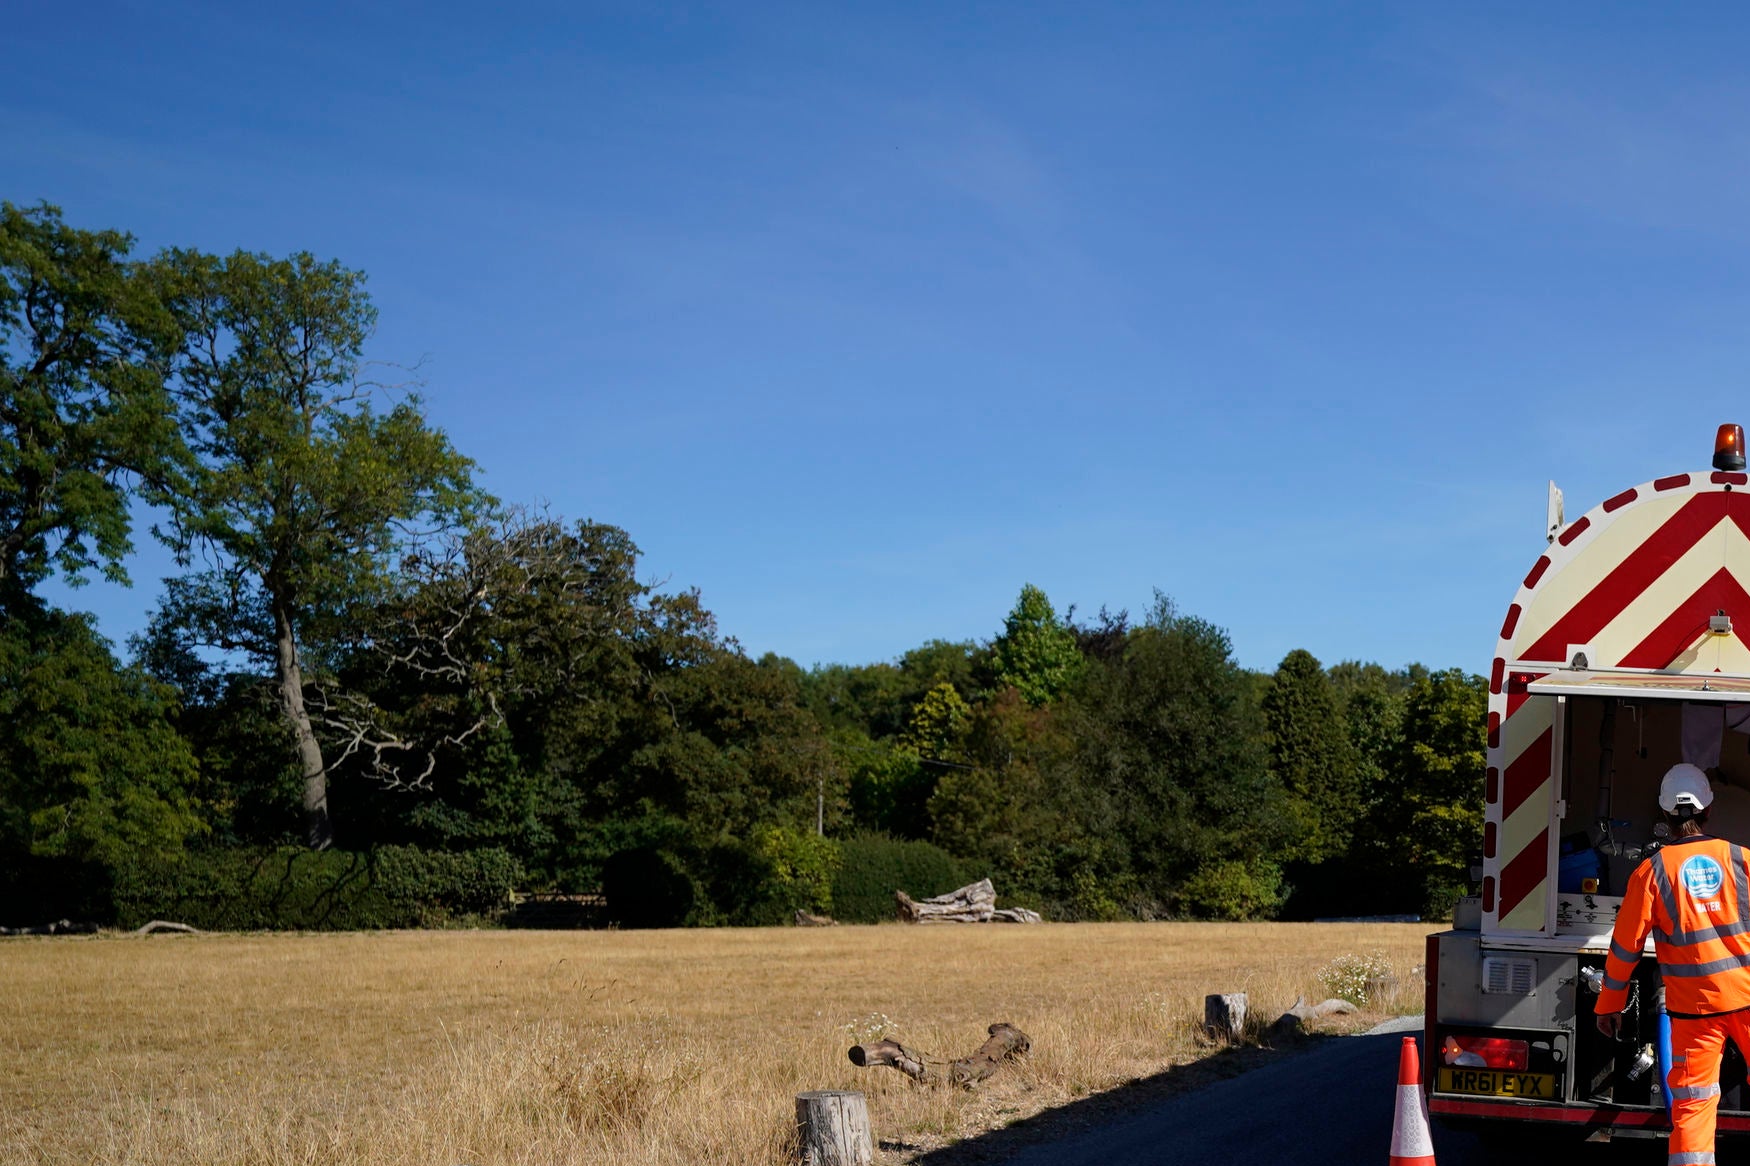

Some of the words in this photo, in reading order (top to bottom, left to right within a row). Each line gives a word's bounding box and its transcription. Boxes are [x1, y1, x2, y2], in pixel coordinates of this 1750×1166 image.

[1685, 867, 1717, 875] Thames
[1690, 874, 1714, 882] Water
[1695, 901, 1721, 912] WATER
[1451, 1070, 1497, 1092] WR61
[1502, 1074, 1543, 1095] EYX
